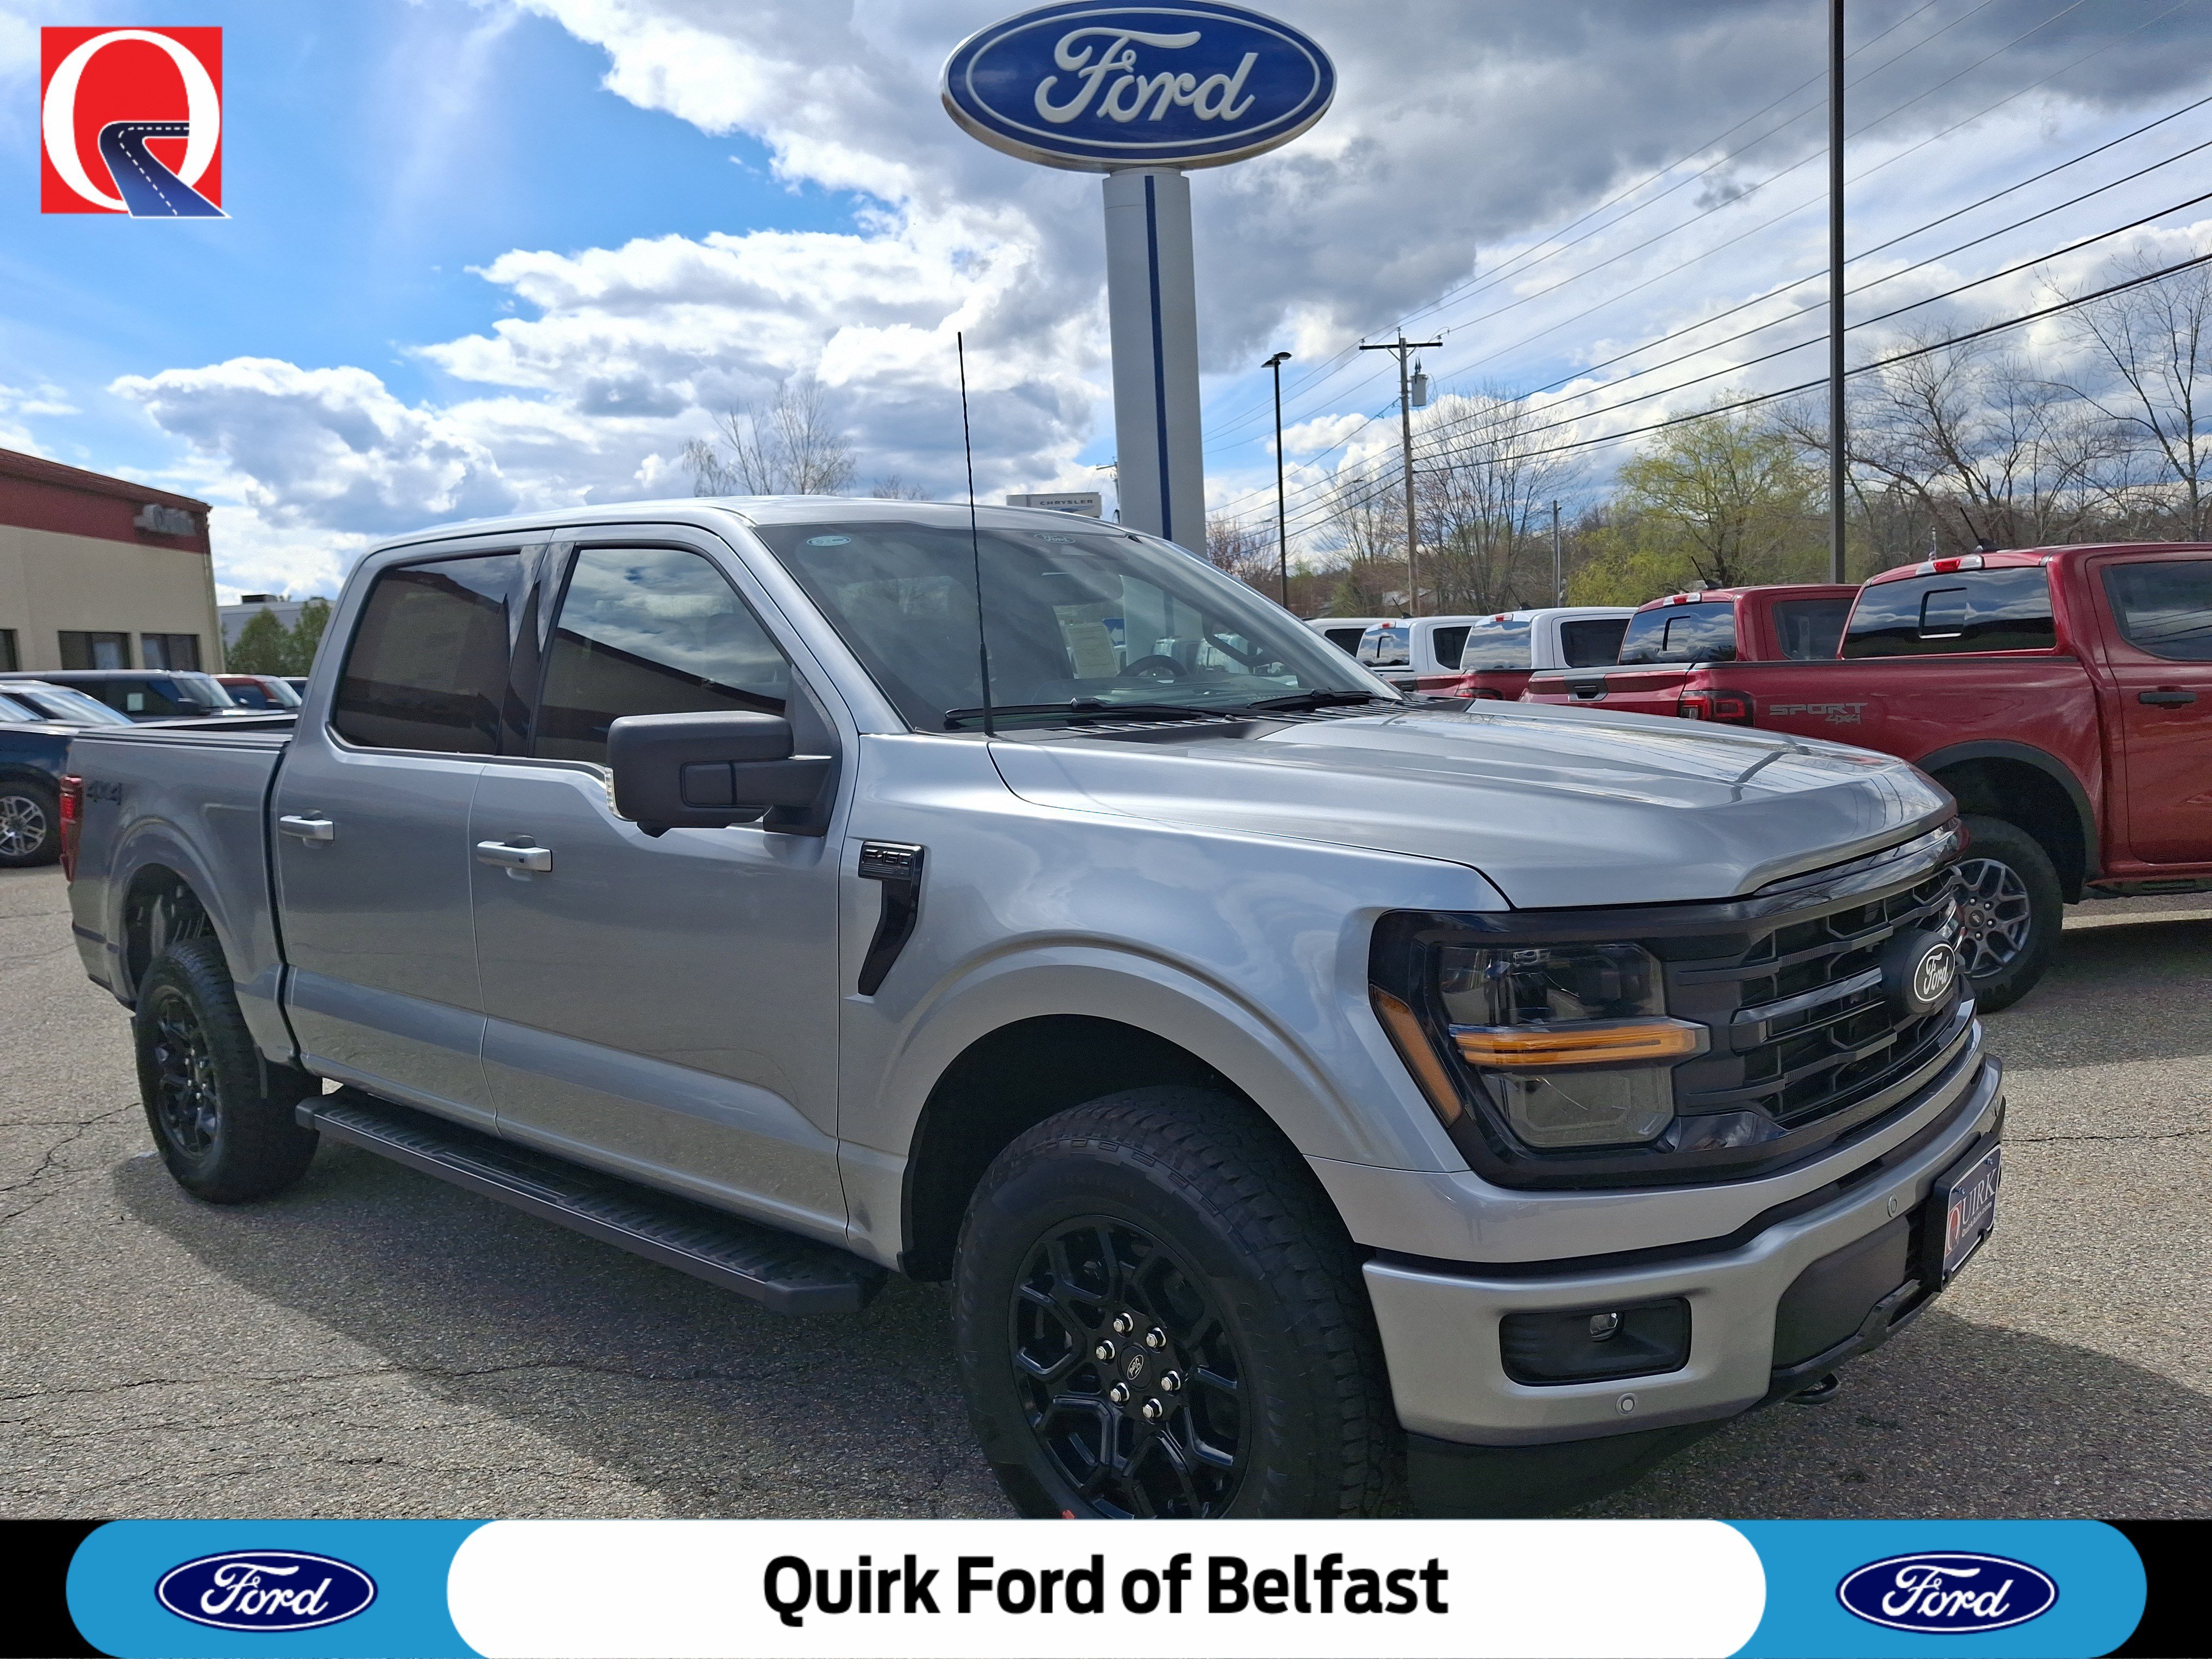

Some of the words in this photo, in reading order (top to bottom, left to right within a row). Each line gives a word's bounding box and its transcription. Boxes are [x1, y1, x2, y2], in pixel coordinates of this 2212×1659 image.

[1034, 27, 1258, 123] Ford
[1770, 703, 1868, 716] SPORT
[863, 848, 912, 866] F-150
[1924, 952, 1949, 995] Ford
[1947, 1168, 1997, 1251] QUIRK
[1129, 1358, 1141, 1377] Ford
